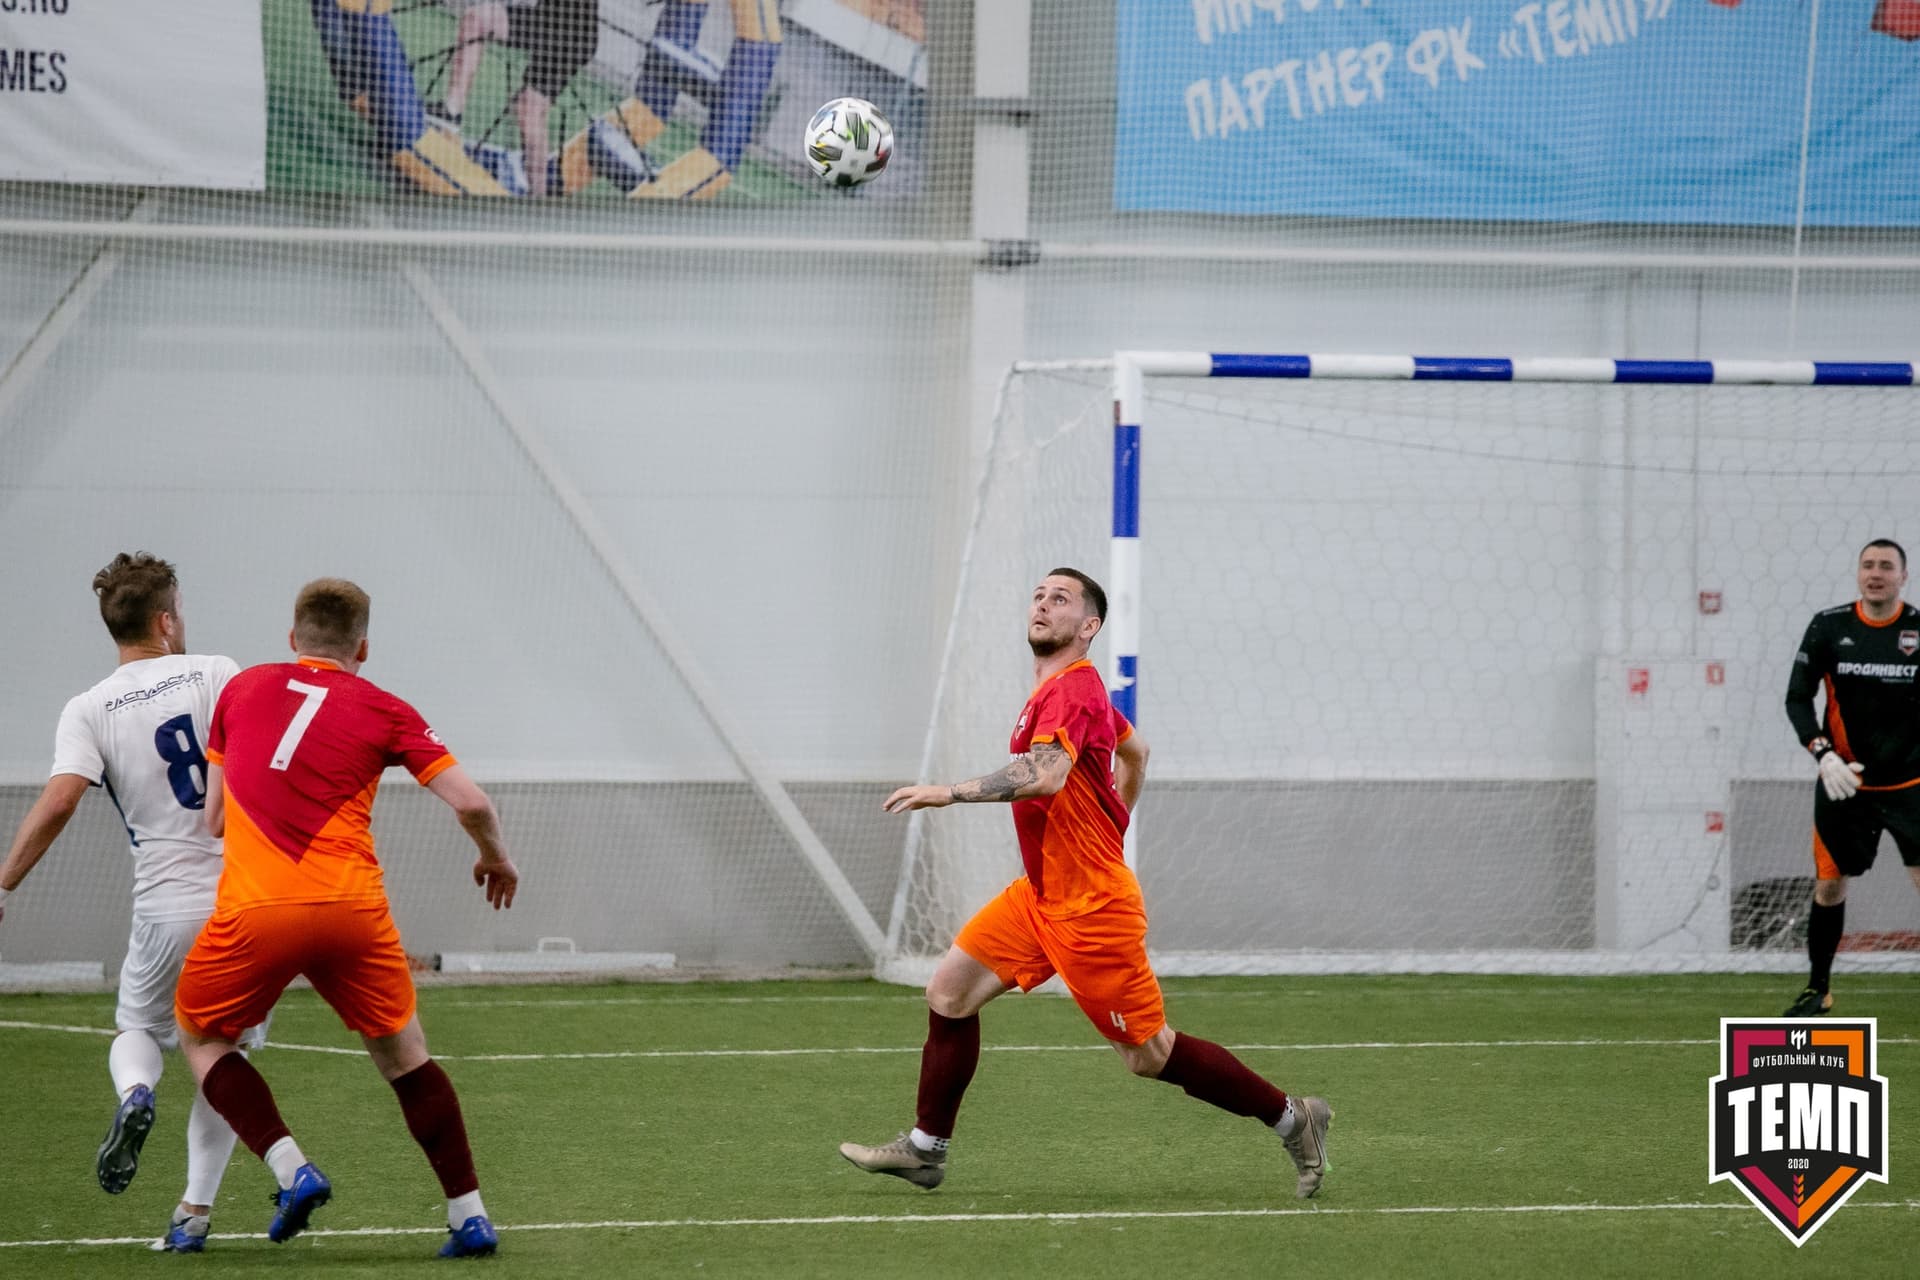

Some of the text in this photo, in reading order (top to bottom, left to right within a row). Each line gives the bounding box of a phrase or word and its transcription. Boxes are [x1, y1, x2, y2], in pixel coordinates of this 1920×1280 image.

[1184, 41, 1393, 141] ПАРТНЕР
[1406, 16, 1486, 88] ФК
[1837, 662, 1919, 677] ПРОДИНВЕСТ
[154, 714, 207, 810] 8
[269, 679, 329, 771] 7
[1110, 1011, 1127, 1032] 4
